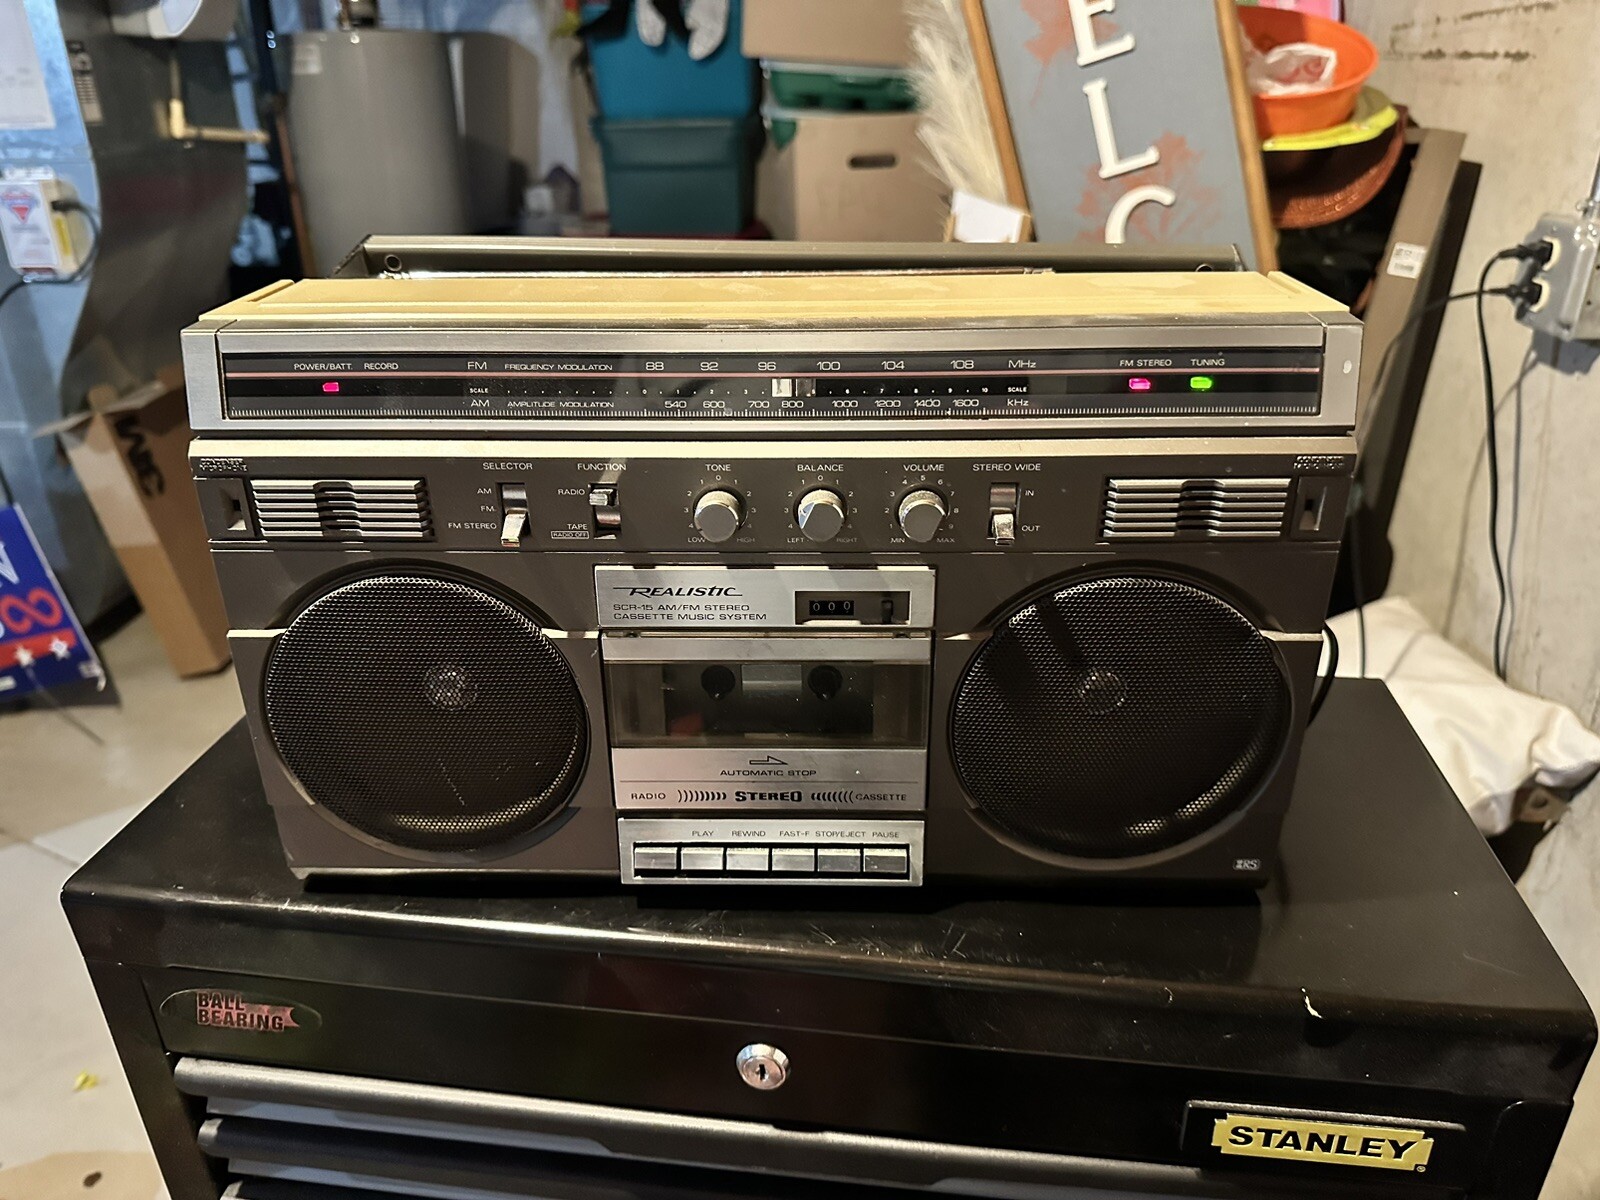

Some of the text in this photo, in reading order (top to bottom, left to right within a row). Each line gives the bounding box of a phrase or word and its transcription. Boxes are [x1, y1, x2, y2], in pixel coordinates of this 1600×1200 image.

[364, 362, 399, 370] RECORD
[467, 361, 613, 371] FM FREQUENCY MODULATION
[645, 360, 1037, 371] 88 92 96 100 104 108 MHz
[1119, 359, 1173, 367] FM STEREO
[1190, 358, 1225, 367] TUNING
[470, 399, 490, 408] AM
[664, 398, 1029, 409] 540 600 700 800 1000 1200 1400 1600 kHz
[483, 462, 533, 470] SELECTOR
[577, 463, 627, 471] FUNCTION
[705, 463, 732, 472] TONE
[797, 464, 844, 472] BALANCE
[903, 464, 945, 472] VOLUME
[972, 463, 1041, 472] STEREO WIDE
[557, 488, 586, 496] RADIO
[1025, 489, 1035, 497] IN
[464, 522, 497, 530] STEREO
[613, 603, 654, 611] SCR-15
[613, 613, 767, 621] CASSETTE MUSIC SYSTEM
[734, 791, 803, 803] STEREO
[855, 793, 908, 801] CASSETTE
[815, 830, 866, 838] STOP/EJECT
[199, 993, 245, 1011] BALL
[199, 1009, 284, 1031] BEARING
[1228, 1125, 1418, 1160] STANLEY
